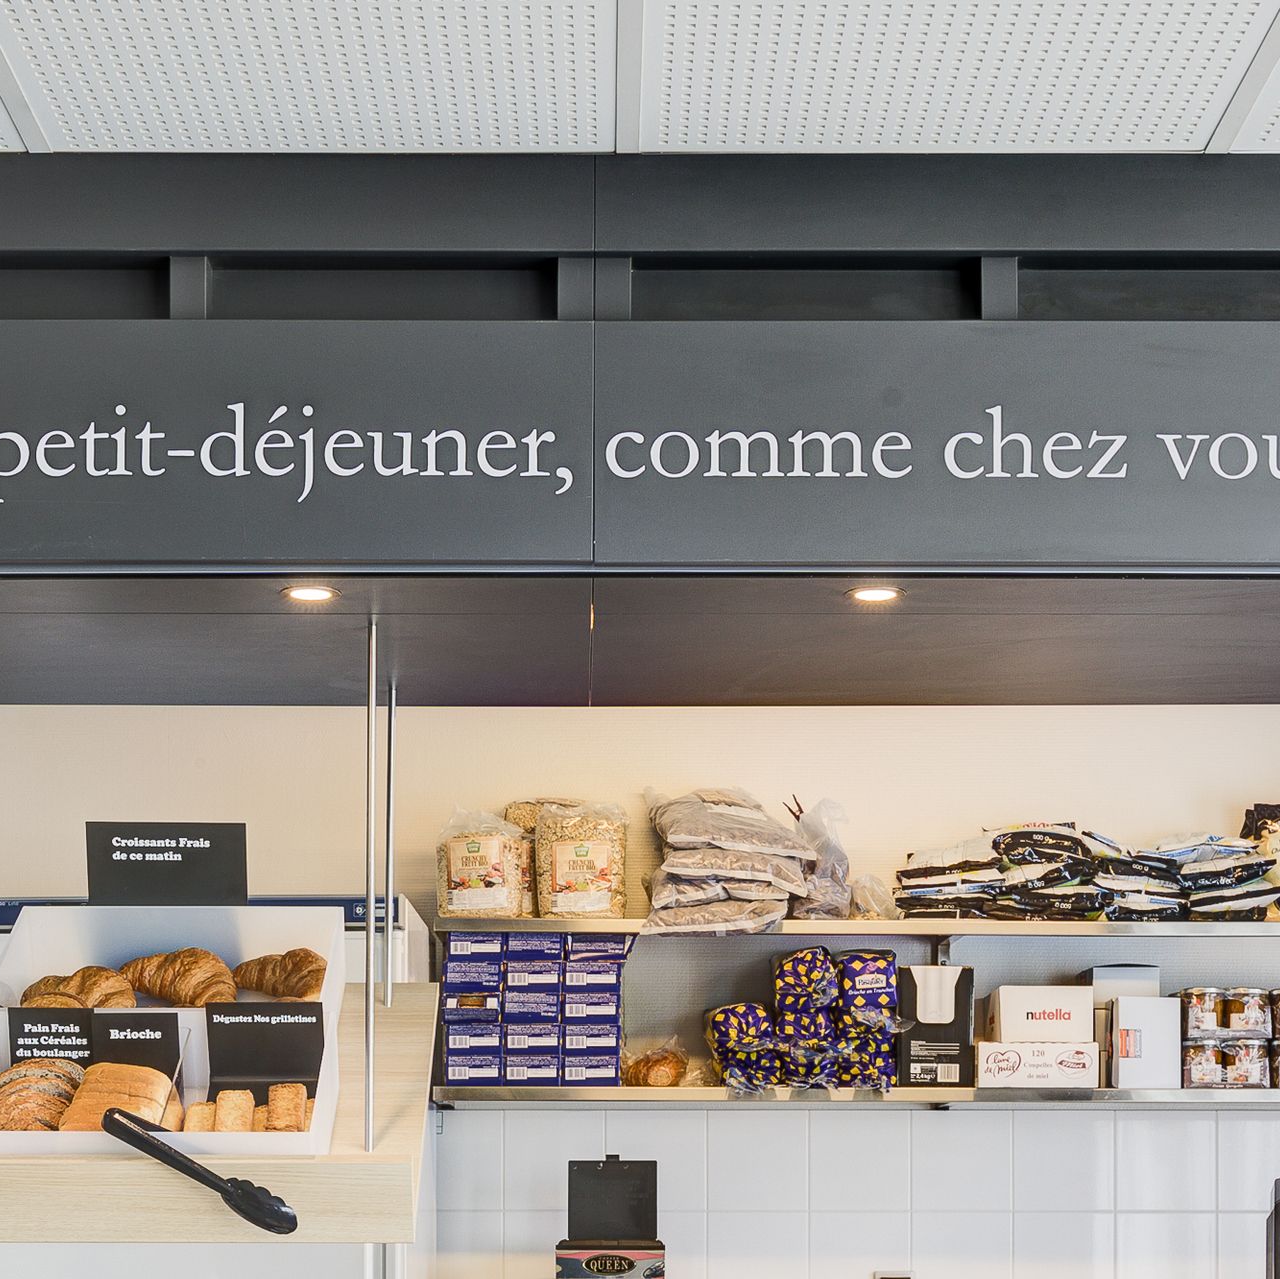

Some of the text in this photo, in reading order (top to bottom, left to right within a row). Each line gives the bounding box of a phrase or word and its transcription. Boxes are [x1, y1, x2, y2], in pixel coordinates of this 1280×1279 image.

[605, 430, 913, 480] comme
[943, 405, 1129, 480] chez
[111, 836, 211, 849] Croissants Frais
[112, 850, 183, 861] de ce matin
[212, 1014, 317, 1025] Dégustez Nos grilletines
[1026, 1008, 1071, 1021] nutella
[23, 1023, 80, 1034] Pain Frais
[109, 1028, 162, 1040] Brioche
[17, 1035, 88, 1046] aux Céréales
[16, 1047, 90, 1060] du boulanger
[590, 1260, 630, 1272] QUEEN
